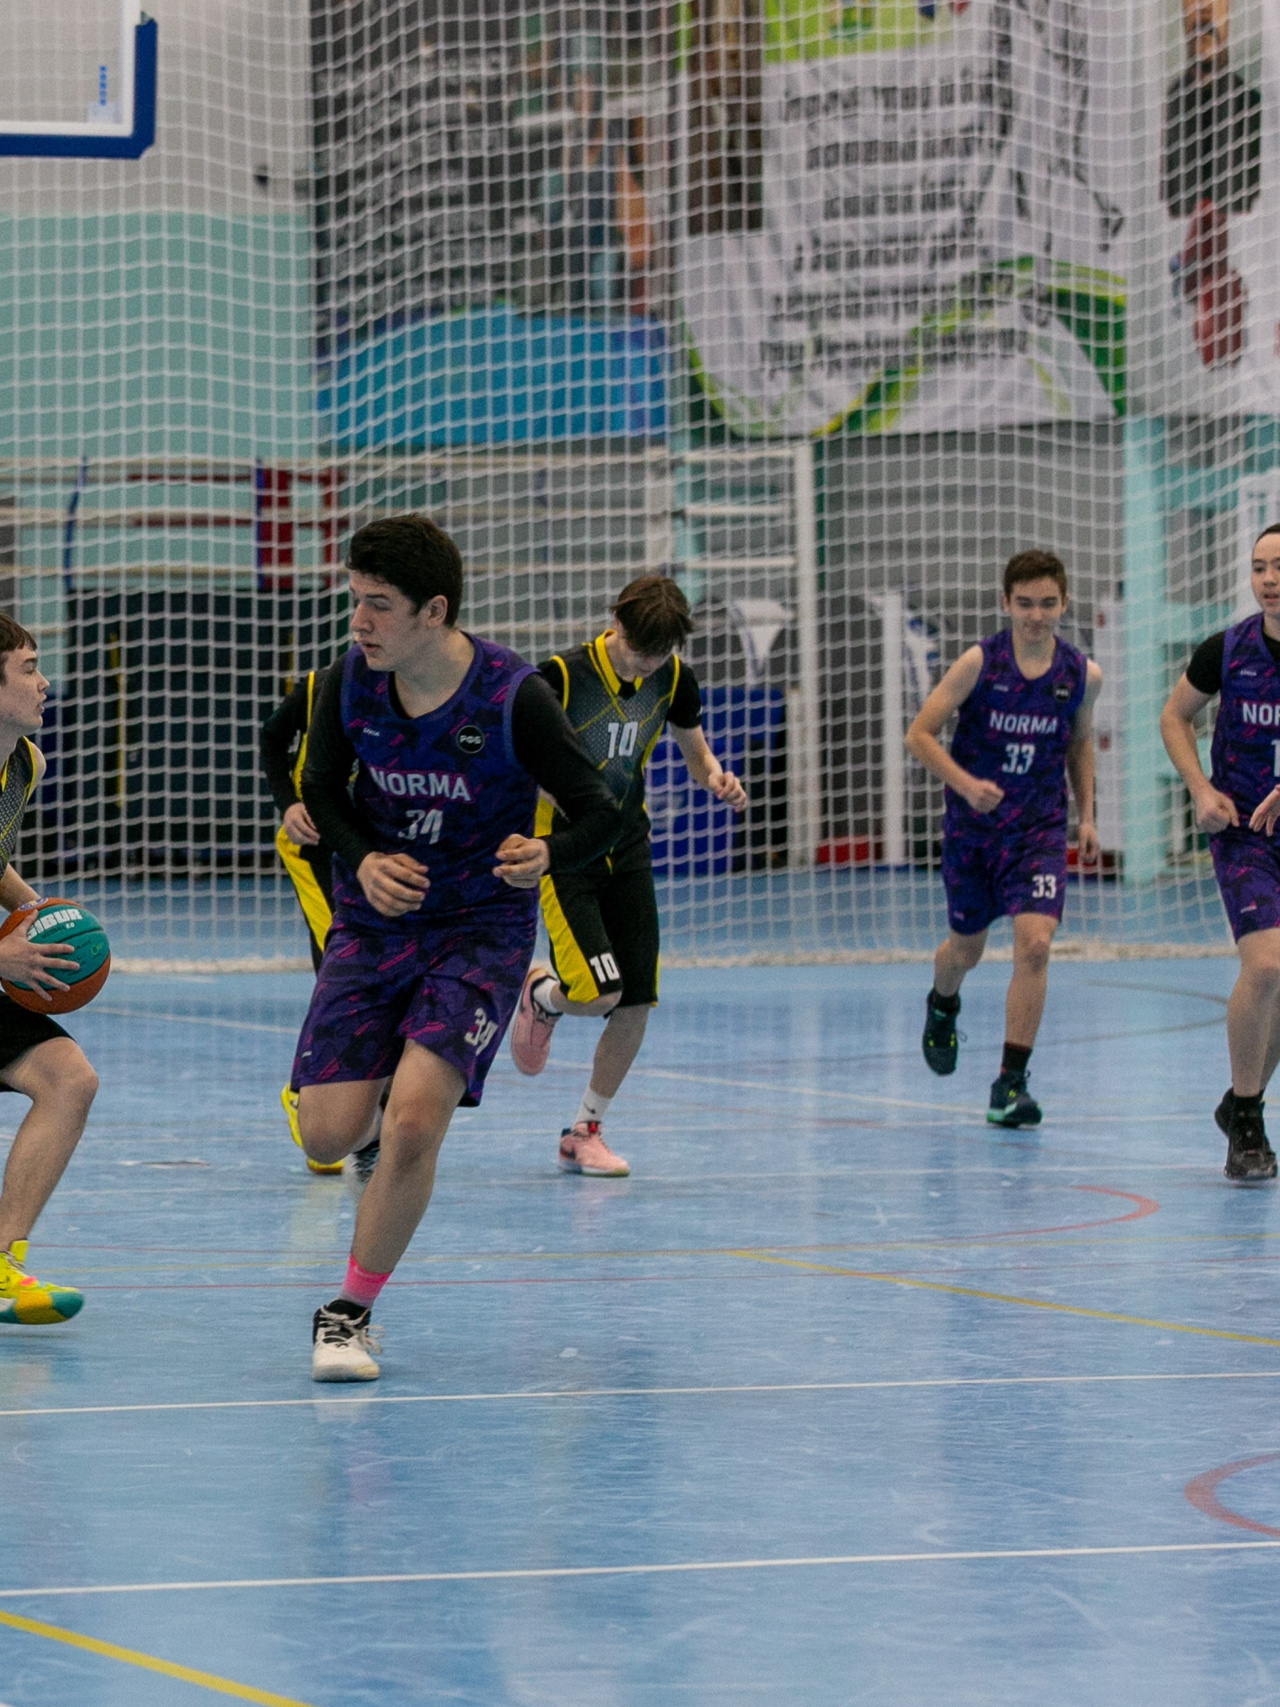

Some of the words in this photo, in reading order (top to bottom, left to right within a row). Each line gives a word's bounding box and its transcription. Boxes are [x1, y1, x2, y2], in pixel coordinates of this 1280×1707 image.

[989, 710, 1058, 734] NORMA
[607, 721, 638, 759] 10
[1002, 743, 1036, 774] 33
[370, 767, 472, 801] NORMA
[397, 809, 443, 845] 34
[1032, 874, 1057, 899] 33
[590, 952, 620, 983] 10
[464, 1007, 499, 1056] 34
